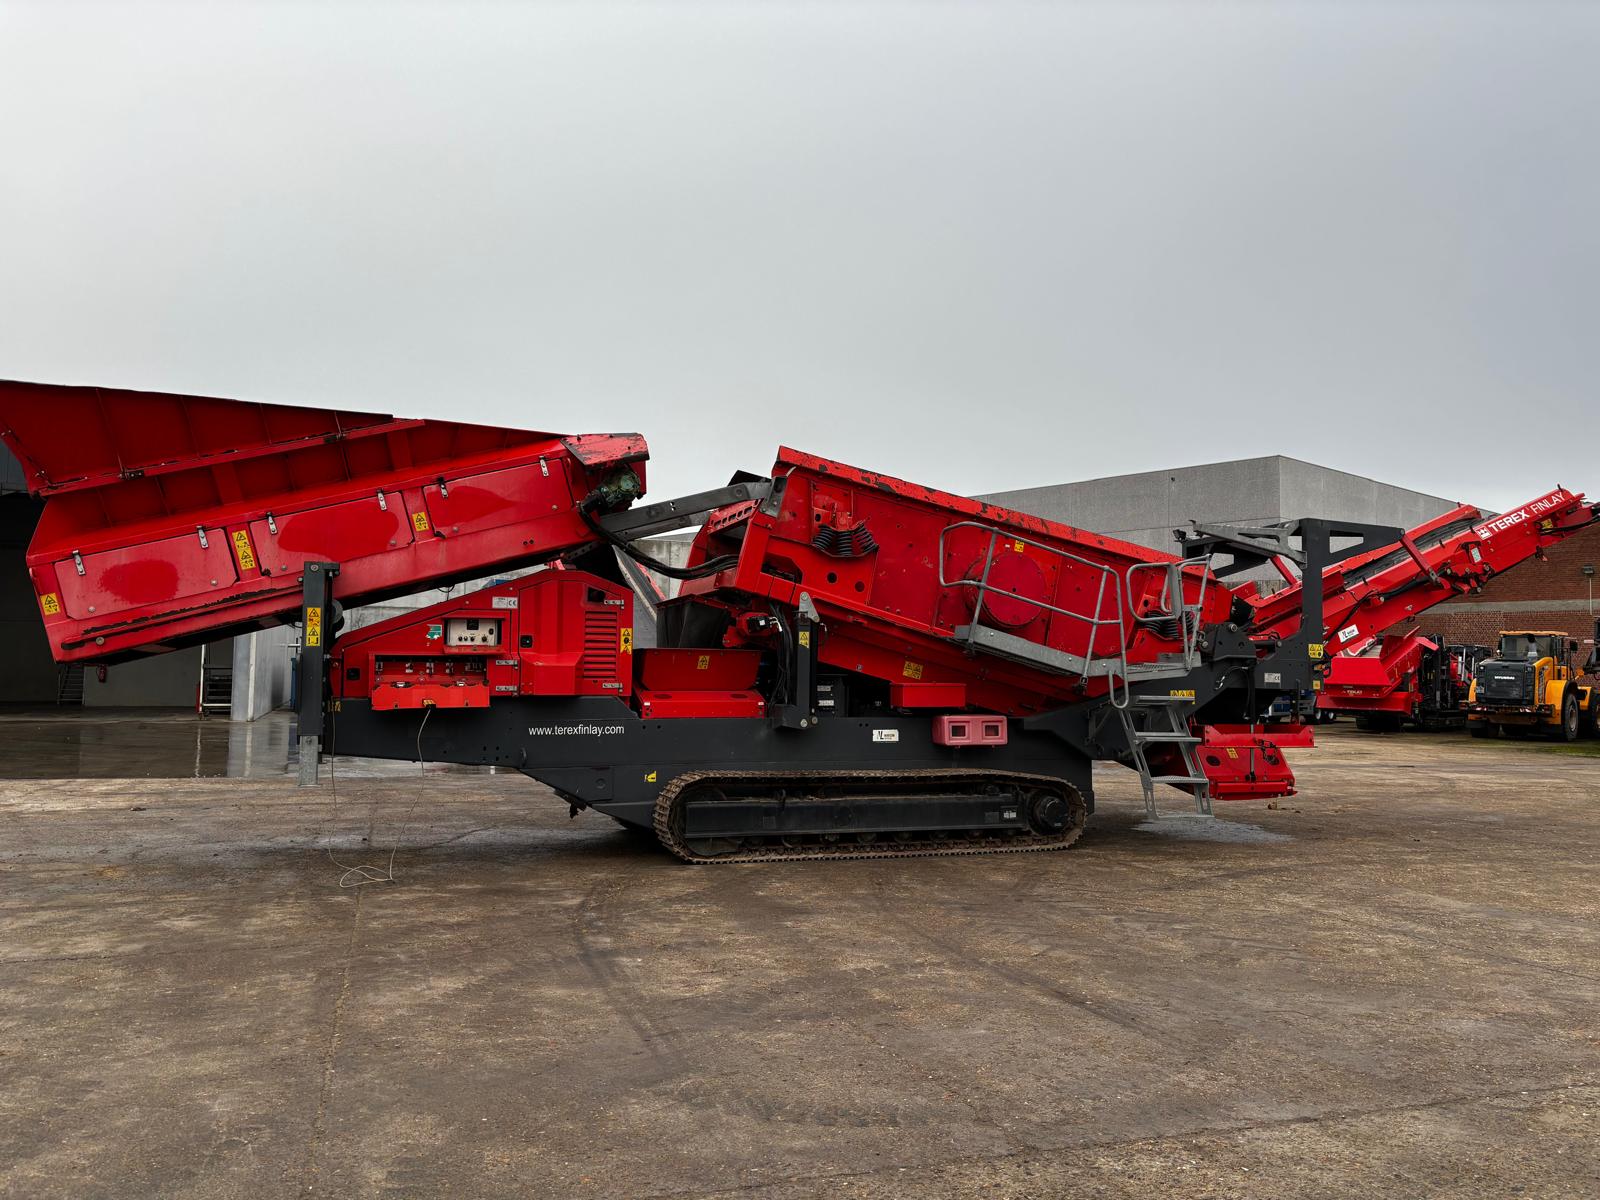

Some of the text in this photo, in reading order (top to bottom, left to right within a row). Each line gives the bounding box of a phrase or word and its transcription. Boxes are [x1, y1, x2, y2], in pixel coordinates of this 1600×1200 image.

[1488, 491, 1566, 532] TEREX FINLAY
[528, 724, 625, 737] www.terexfinlay.com
